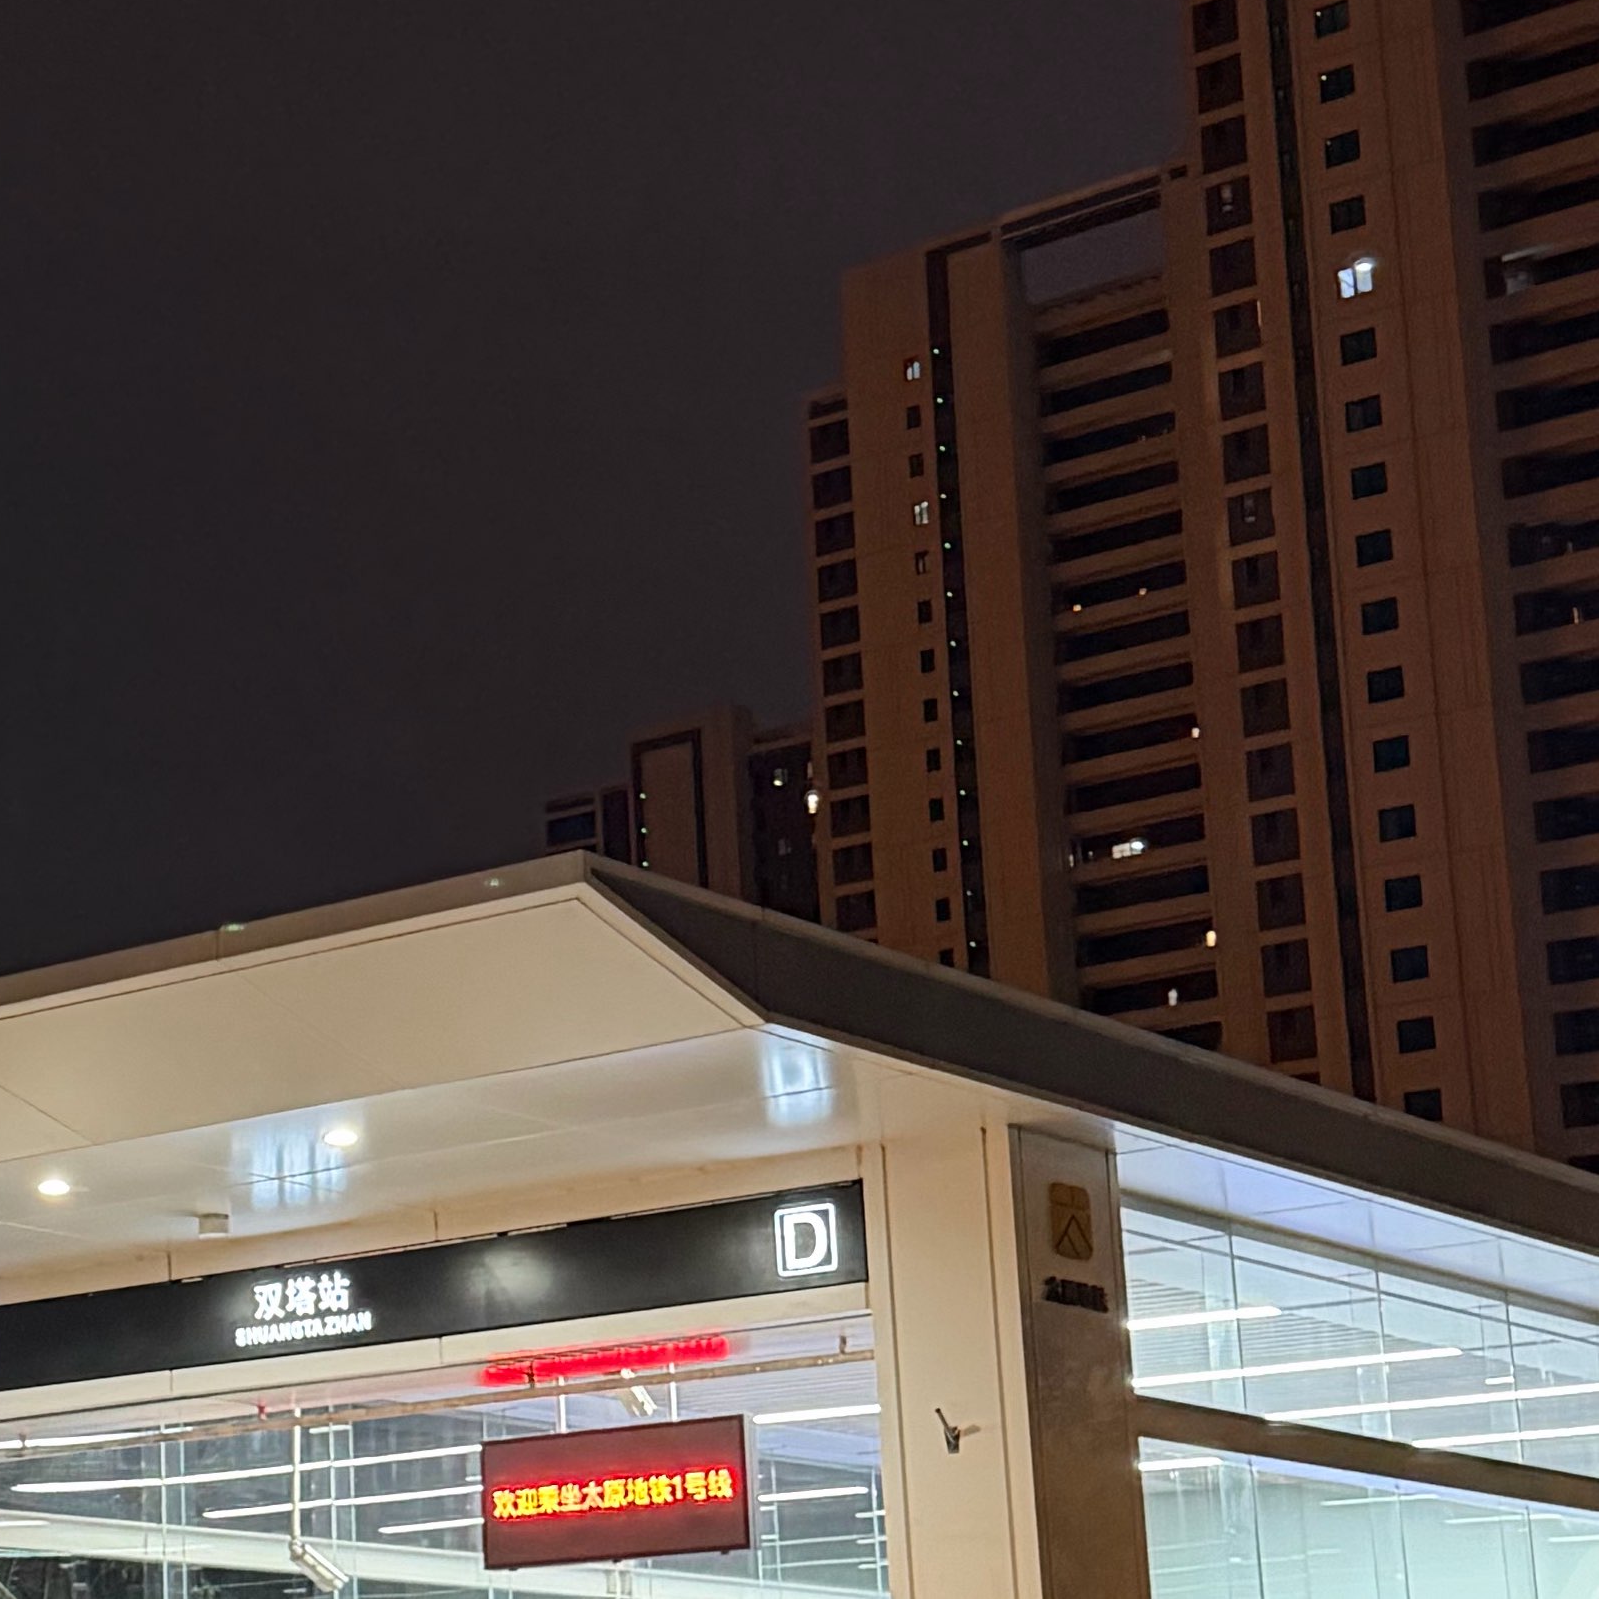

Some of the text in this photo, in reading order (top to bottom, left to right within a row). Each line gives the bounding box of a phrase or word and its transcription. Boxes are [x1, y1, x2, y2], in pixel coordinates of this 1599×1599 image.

[783, 1211, 828, 1271] D
[253, 1270, 351, 1321] 双塔站
[492, 1469, 734, 1519] 欢迎乘坐太原地铁1号线
